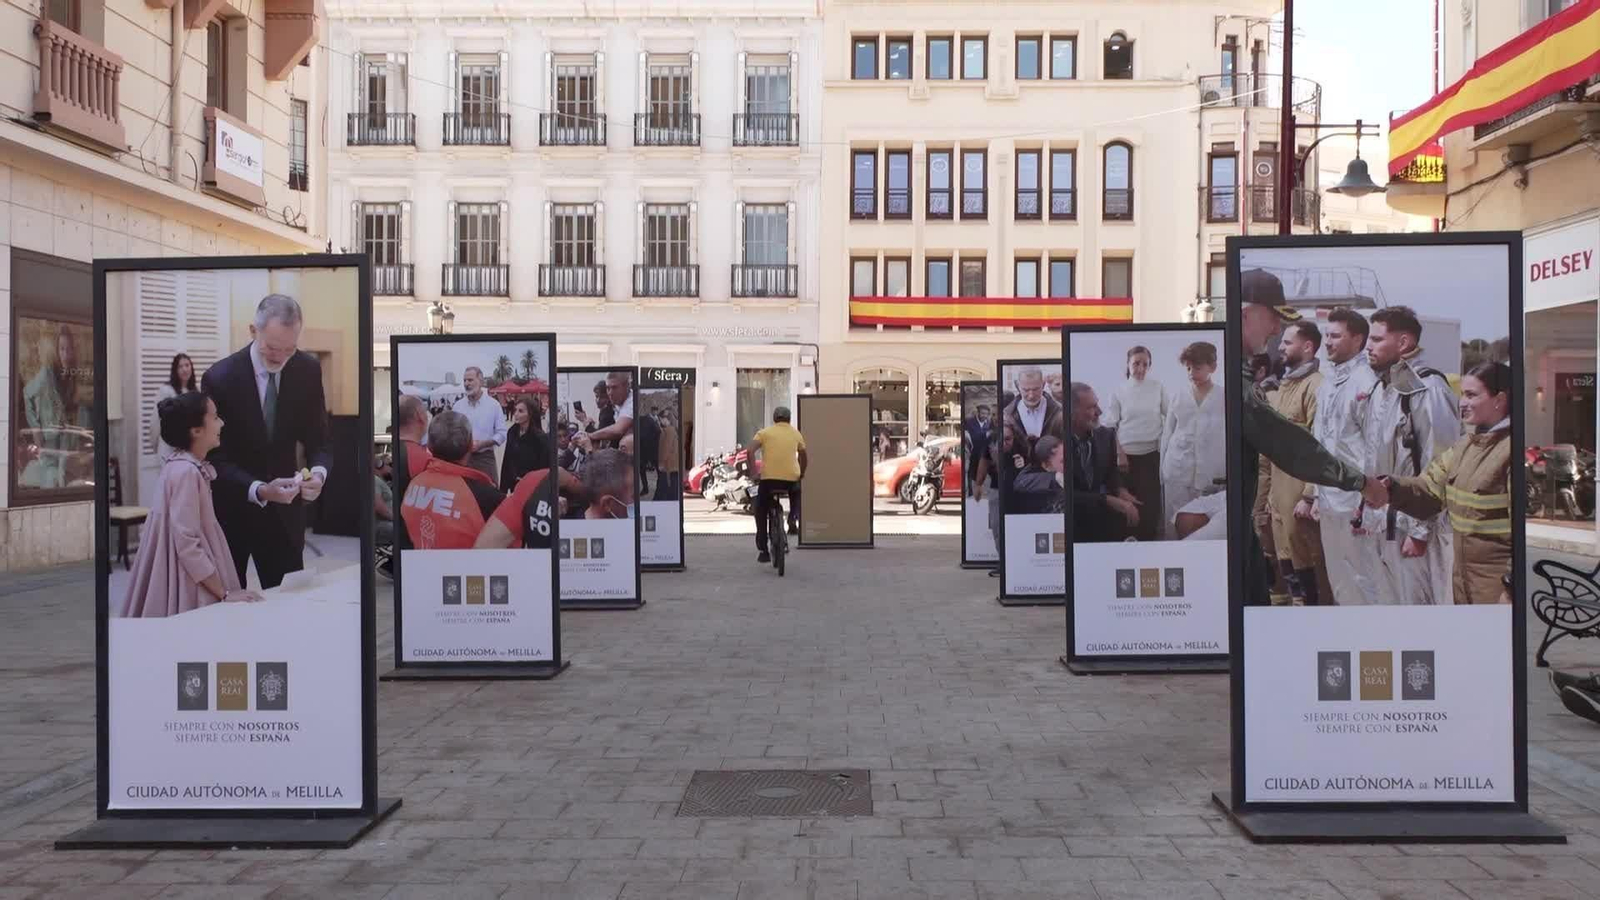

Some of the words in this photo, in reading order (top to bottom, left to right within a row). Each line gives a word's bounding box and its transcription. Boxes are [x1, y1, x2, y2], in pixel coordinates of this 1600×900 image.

[1530, 249, 1593, 282] DELSEY
[413, 648, 445, 657] CIUDAD
[447, 646, 497, 657] AUTÓNOMA
[508, 648, 542, 656] MELILLA
[1086, 643, 1119, 652] CIUDAD
[1121, 641, 1173, 650] AUTÓNOMA
[1184, 641, 1219, 650] MELILLA
[1363, 667, 1388, 676] CASA
[1364, 677, 1387, 685] REAL
[221, 687, 242, 695] REAL
[1303, 712, 1349, 722] SIEMPRE
[1352, 712, 1379, 721] CON
[1383, 711, 1448, 721] NOSOTROS
[164, 722, 206, 731] SIEMPRE
[209, 722, 234, 731] CON
[238, 721, 300, 731] NOSOTROS
[1316, 724, 1362, 734] SIEMPRE
[1365, 724, 1392, 733] CON
[1395, 722, 1438, 733] ESPAÑA
[175, 733, 219, 742] SIEMPRE
[221, 733, 246, 742] CON
[250, 731, 291, 742] ESPAÑA
[1264, 778, 1320, 790] CIUDAD
[1325, 775, 1414, 790] AUTÓNOMA
[1434, 777, 1494, 790] MELILLA
[126, 786, 178, 798] CIUDAD
[183, 783, 267, 798] AUTÓNOMA
[286, 785, 343, 798] MELILLA
